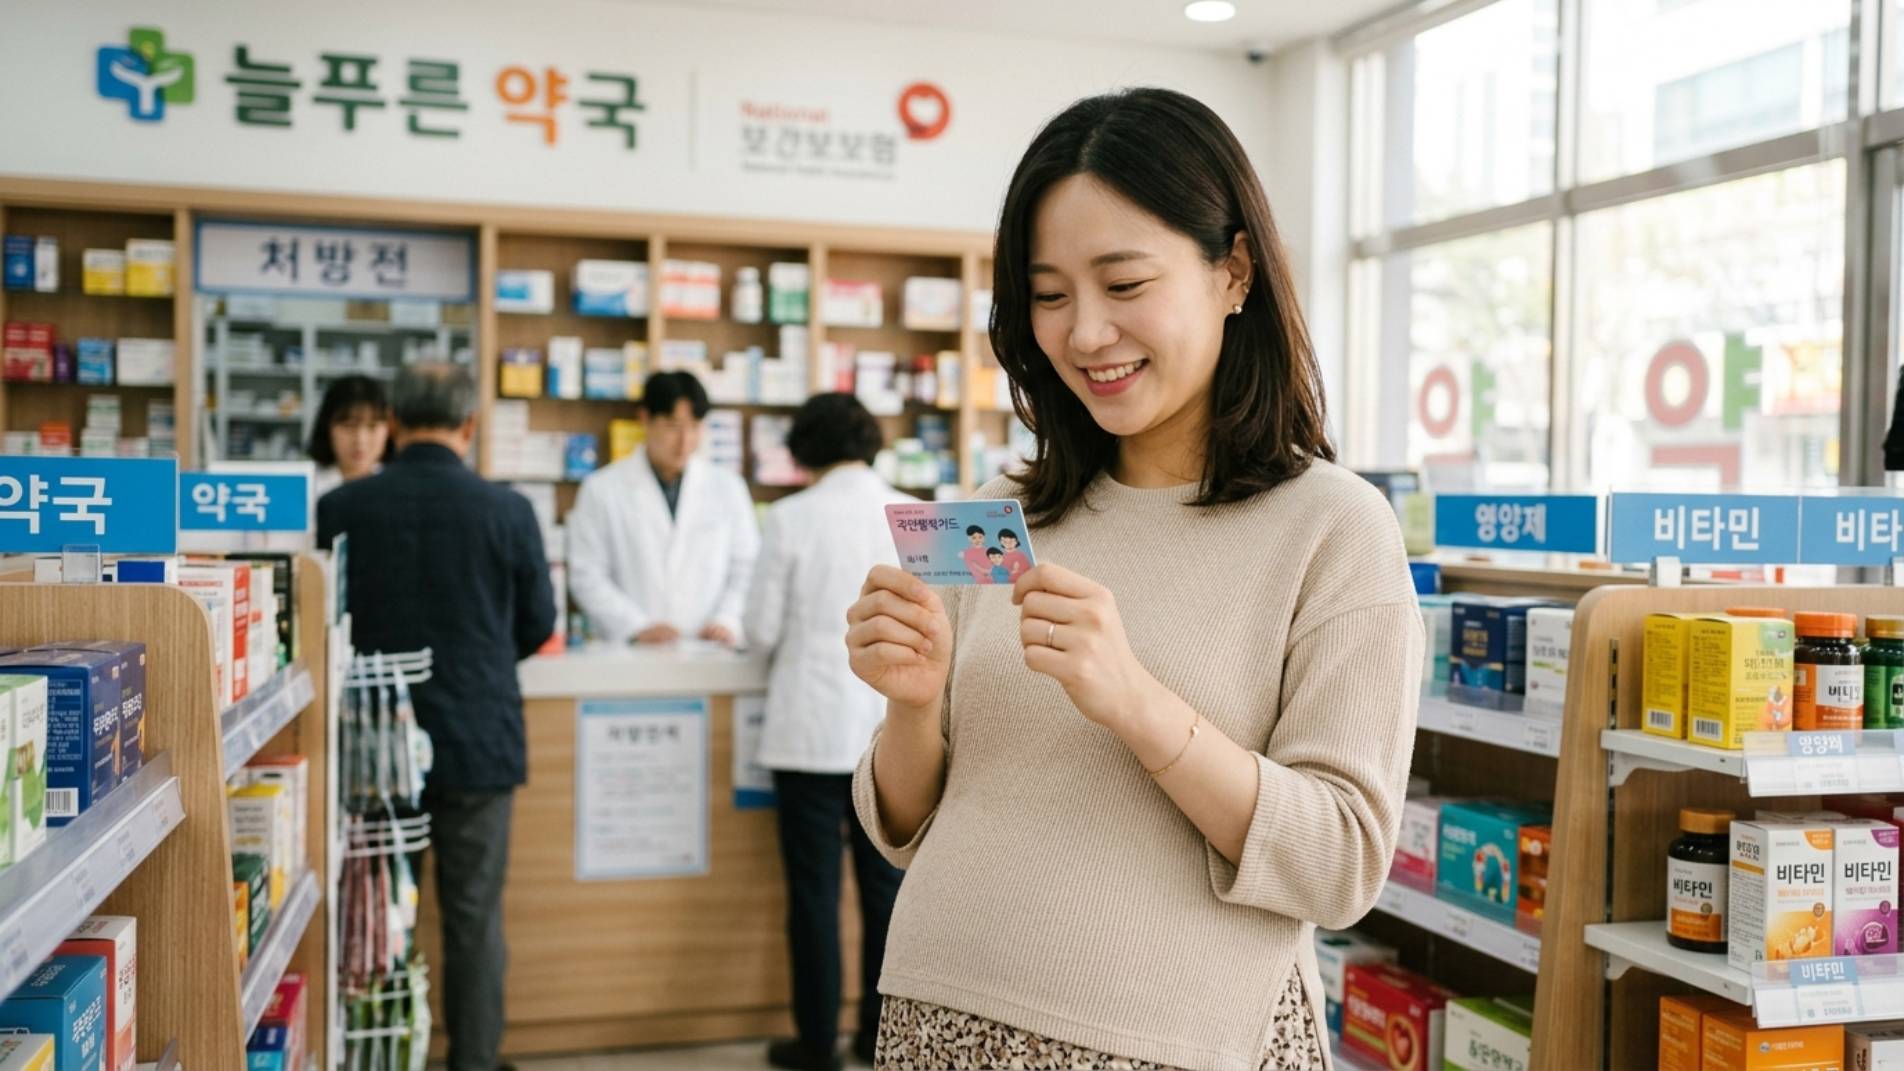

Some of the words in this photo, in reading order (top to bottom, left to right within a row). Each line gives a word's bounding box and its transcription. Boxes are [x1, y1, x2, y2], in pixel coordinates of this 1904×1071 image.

[224, 44, 469, 138] 늘푸른
[494, 65, 646, 150] 약국
[259, 236, 408, 287] 처방전
[0, 474, 113, 536] 약국
[191, 482, 271, 524] 약국
[1474, 502, 1548, 544] 영양제
[1653, 506, 1760, 551] 비타민
